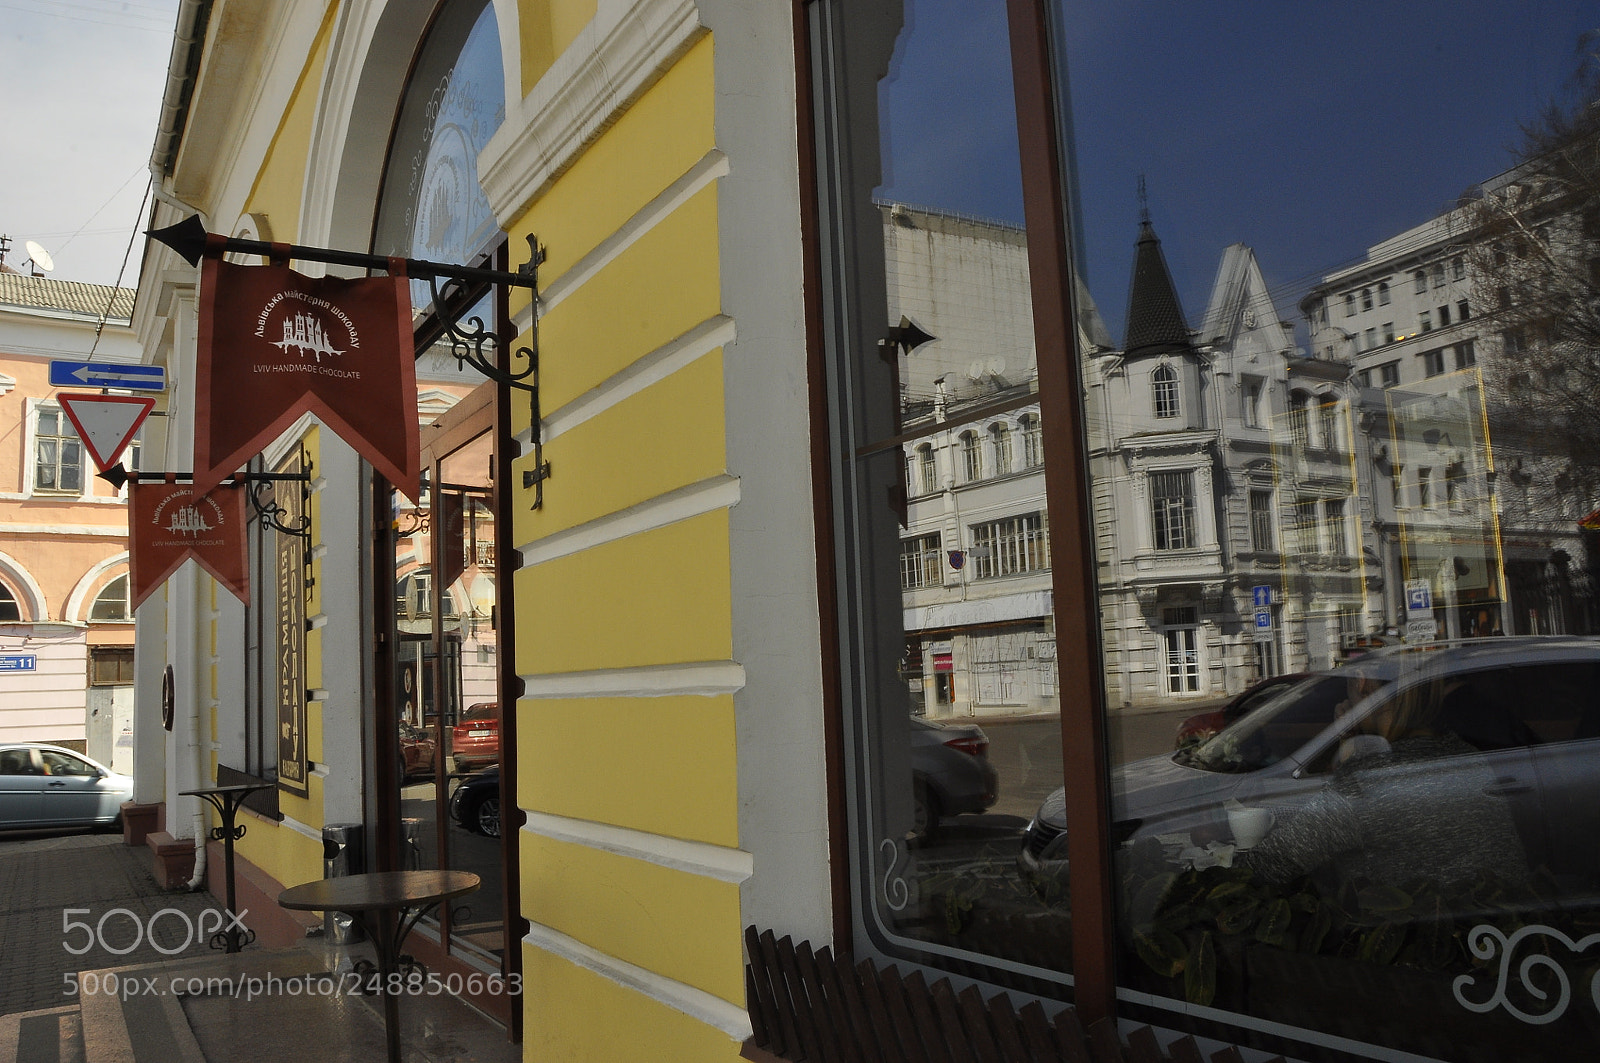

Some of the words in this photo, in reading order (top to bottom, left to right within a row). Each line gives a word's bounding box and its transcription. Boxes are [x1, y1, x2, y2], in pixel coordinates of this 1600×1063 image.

[284, 289, 331, 309] майстерня
[330, 305, 360, 349] шоколаду
[253, 364, 271, 373] LVIV
[272, 364, 317, 374] HANDMADE
[318, 366, 361, 380] CHOCOLATE
[281, 550, 289, 706] КРАМНИЦЯ
[19, 658, 32, 668] 11
